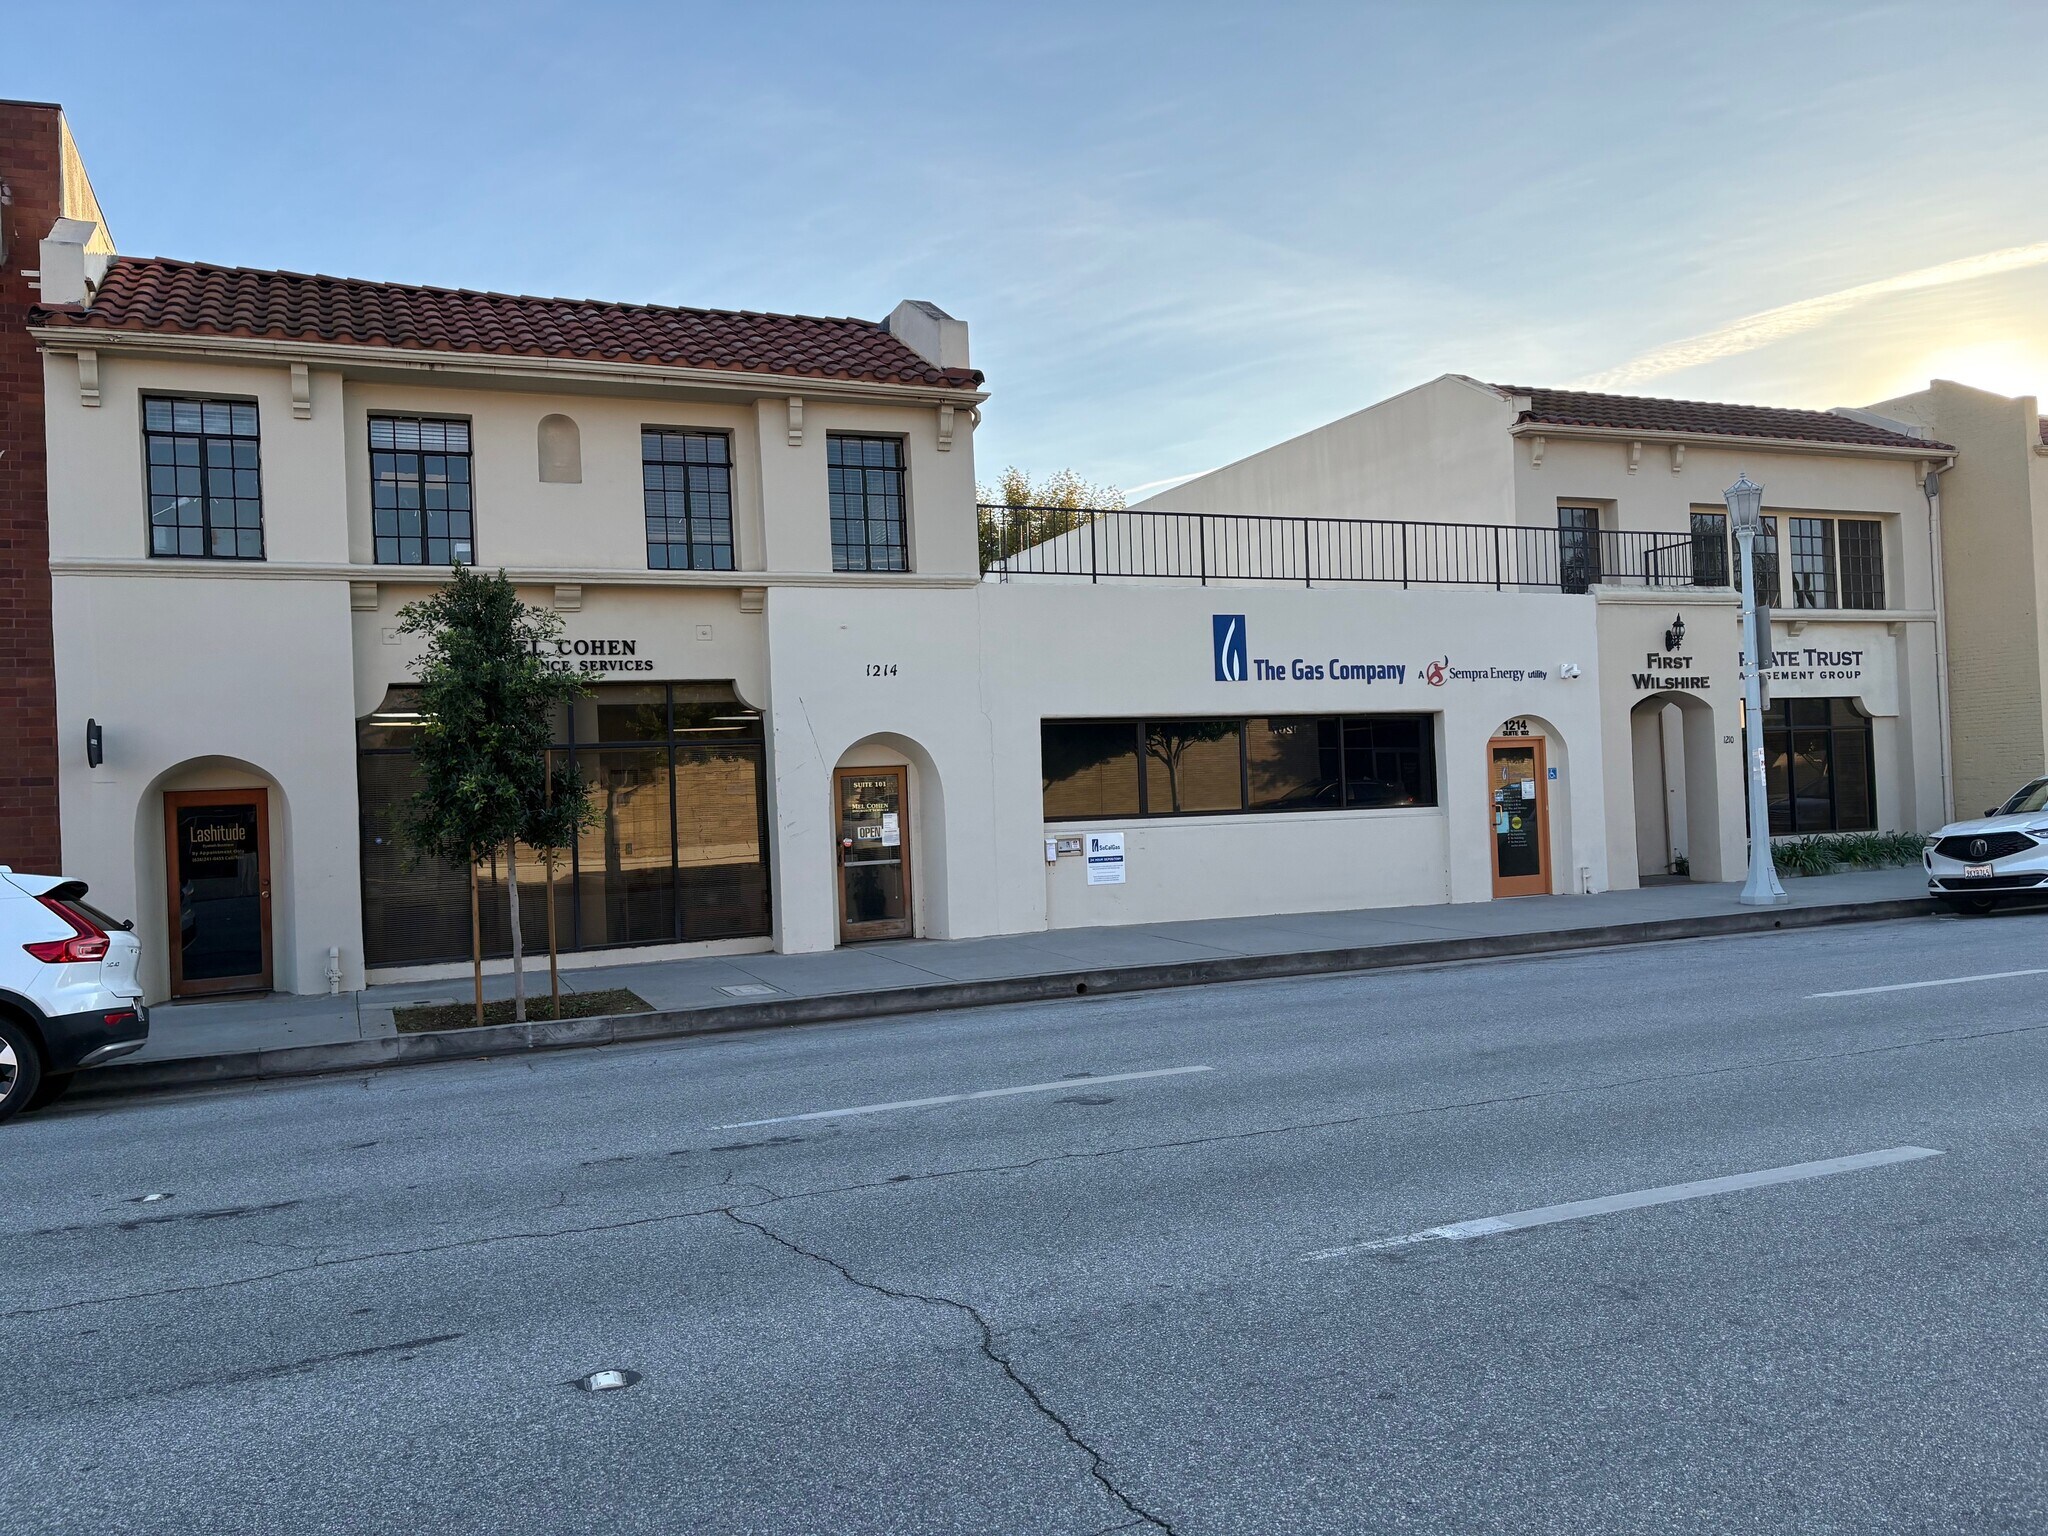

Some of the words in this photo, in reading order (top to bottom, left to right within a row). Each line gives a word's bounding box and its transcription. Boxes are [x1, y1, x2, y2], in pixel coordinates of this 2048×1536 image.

[557, 640, 637, 656] COHEN
[579, 660, 654, 671] SERVICES
[866, 663, 898, 677] 1214
[1253, 659, 1286, 681] The
[1291, 658, 1325, 681] Gas
[1329, 658, 1406, 685] Company
[1417, 670, 1425, 680] A
[1449, 667, 1489, 682] Sempra
[1490, 666, 1525, 682] Energy
[1527, 669, 1548, 681] utility
[1820, 671, 1862, 679] GROUP
[1503, 719, 1528, 731] 1214
[190, 822, 246, 843] Lashitude
[859, 826, 881, 838] OPEN
